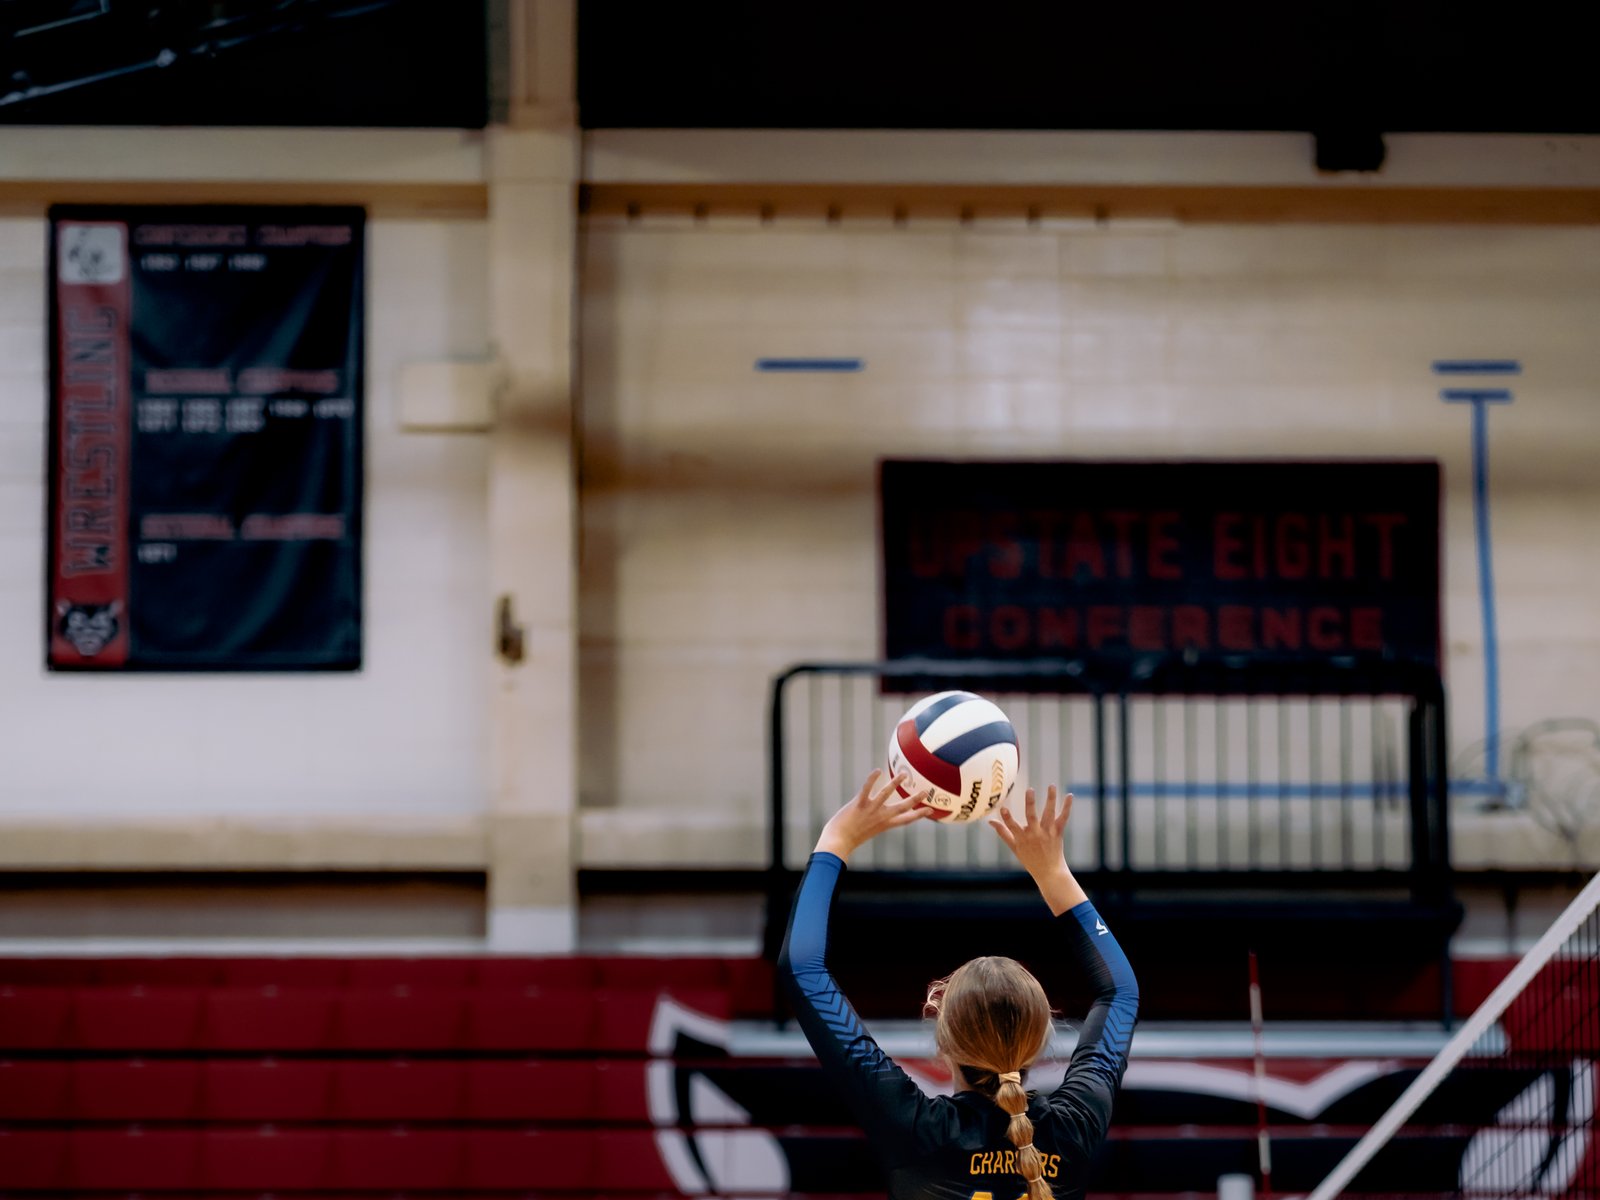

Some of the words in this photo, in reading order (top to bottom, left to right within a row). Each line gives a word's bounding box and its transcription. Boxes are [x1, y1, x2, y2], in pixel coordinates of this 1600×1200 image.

[61, 306, 117, 578] WRESTLING
[909, 508, 1184, 581] UPSTATE
[1212, 511, 1407, 581] EIGHT
[942, 605, 1385, 651] CONFERENCE
[969, 1150, 1062, 1178] CHARRS
